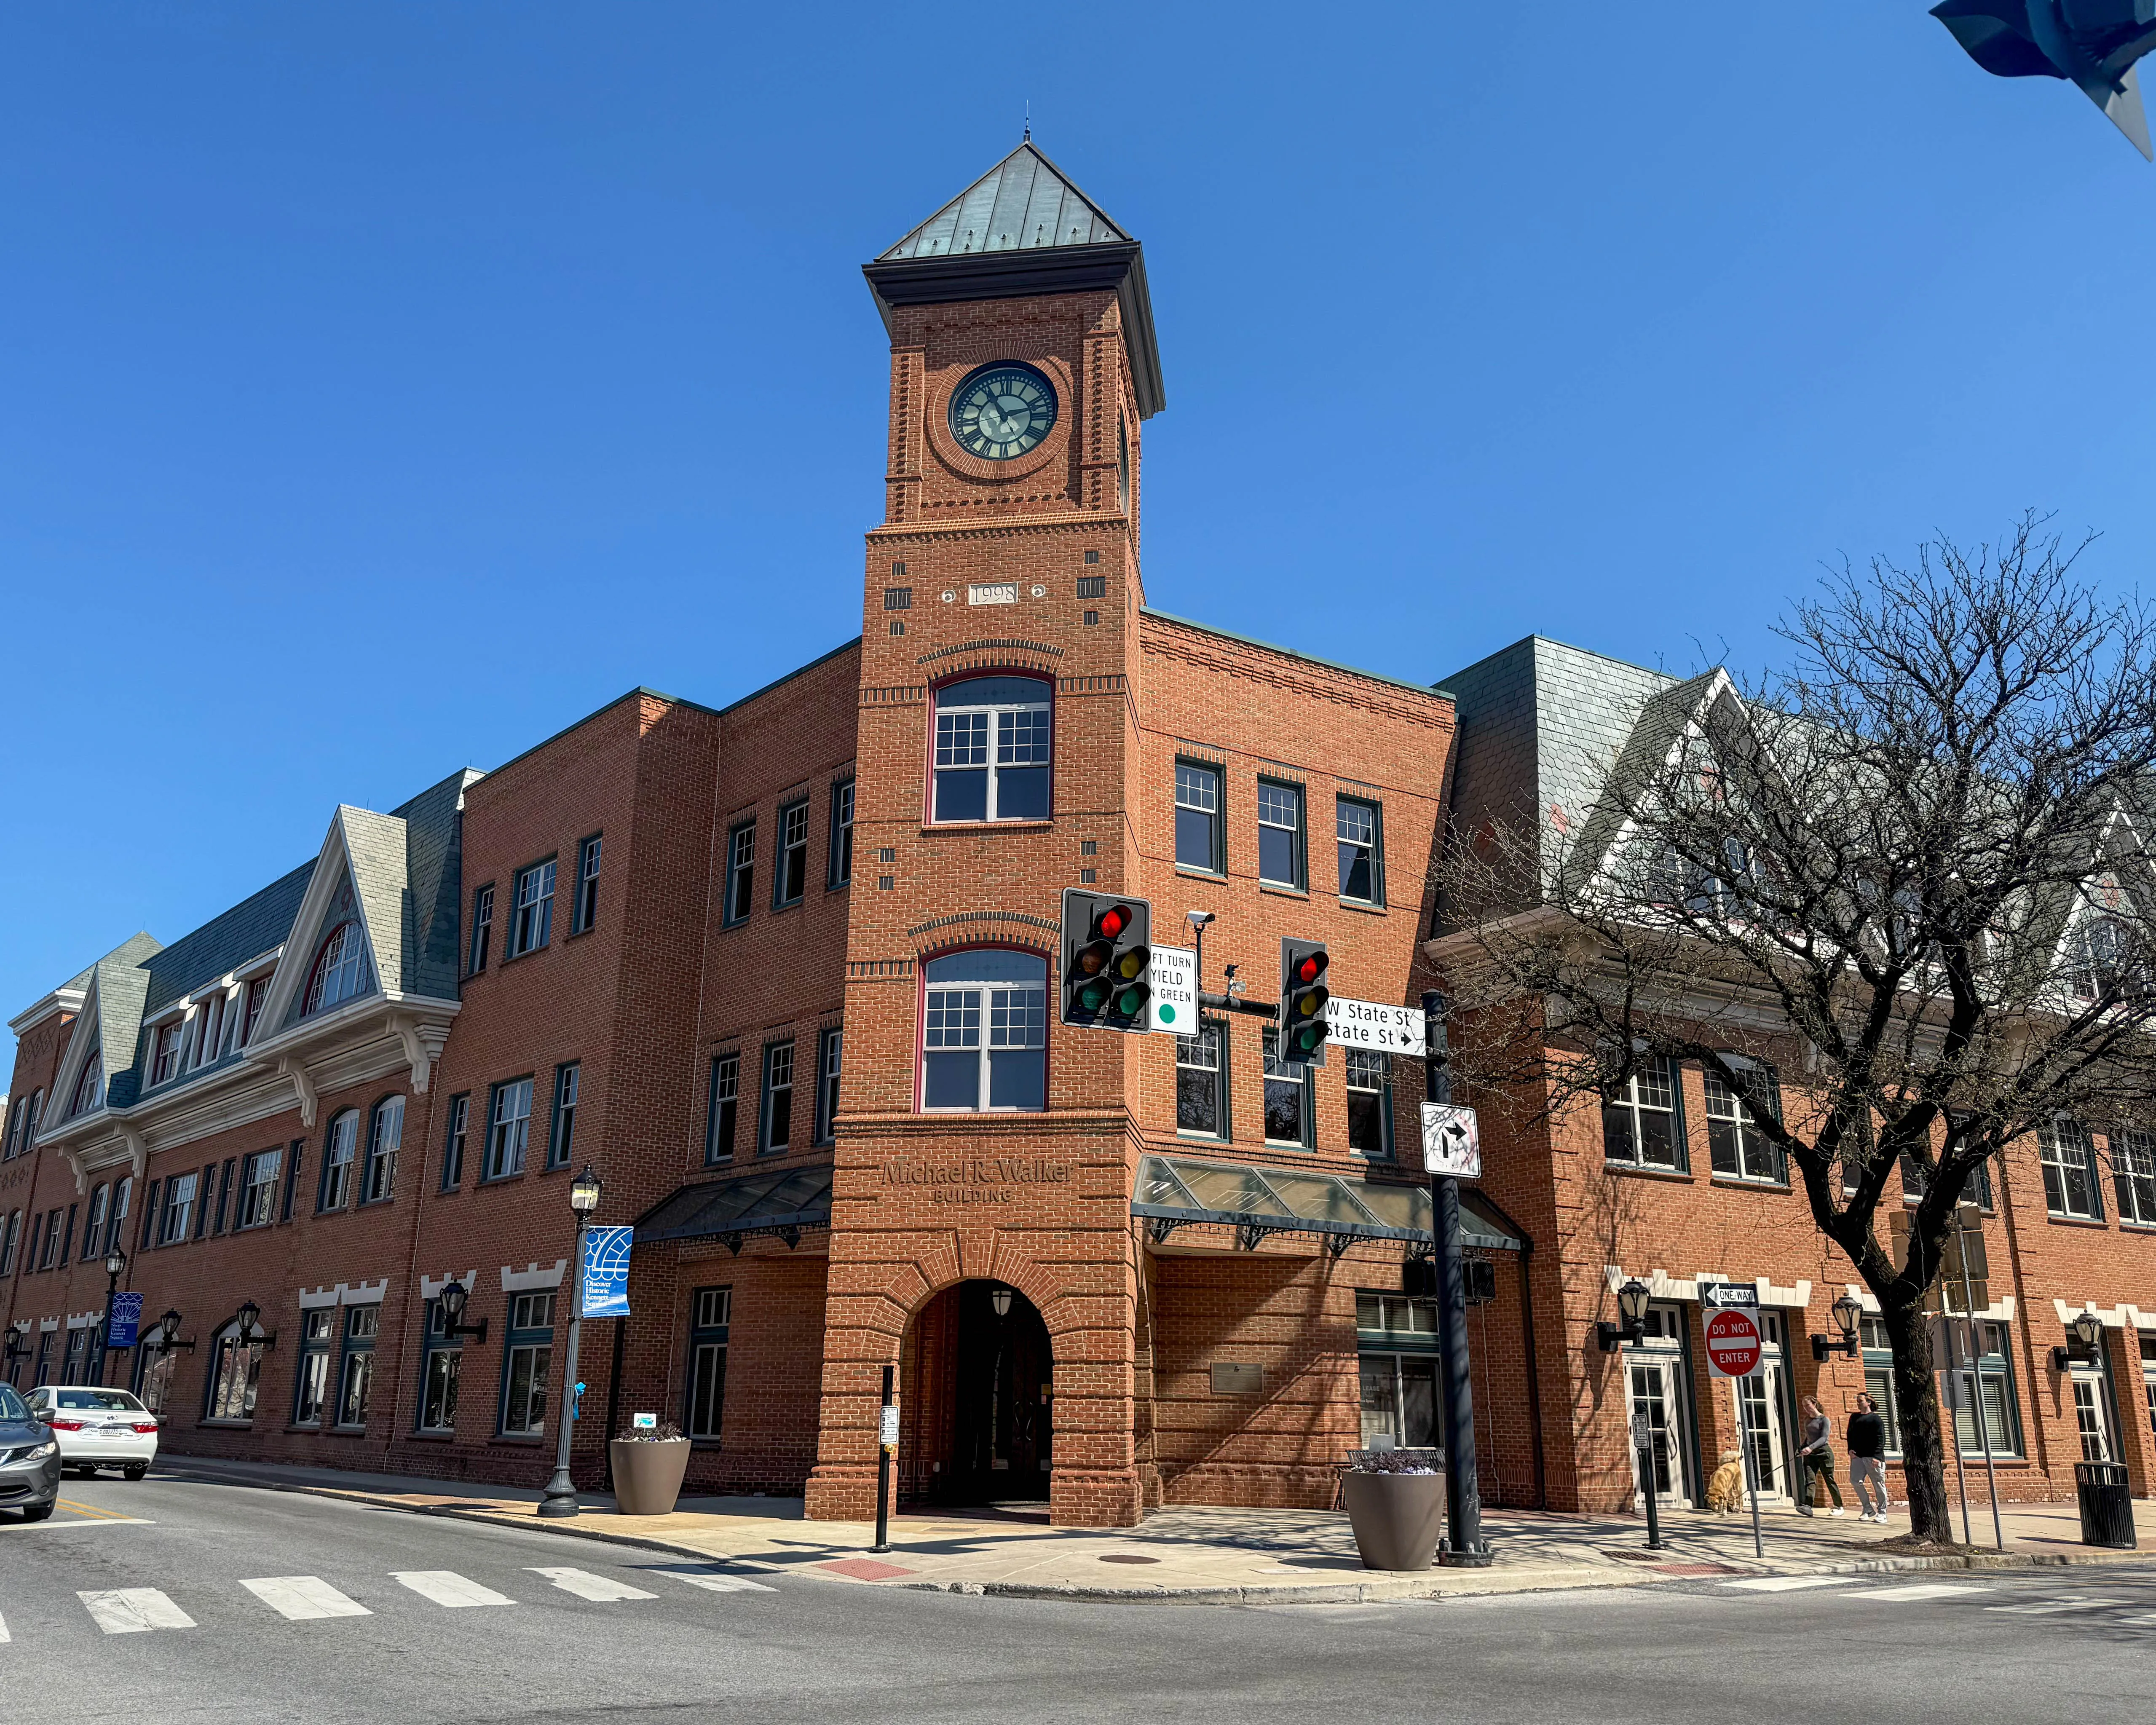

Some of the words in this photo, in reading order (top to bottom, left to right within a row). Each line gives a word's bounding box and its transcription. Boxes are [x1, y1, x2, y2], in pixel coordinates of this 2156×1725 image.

[972, 585, 1015, 603] 1998
[1167, 955, 1191, 969] TURN
[1151, 969, 1183, 985] YIELD
[1160, 988, 1191, 1003] GREEN
[1327, 1000, 1339, 1016] W
[1348, 1004, 1388, 1023] State
[1396, 1011, 1410, 1026] St
[1326, 1021, 1369, 1041] State
[1379, 1029, 1394, 1045] St
[882, 1160, 967, 1184] Michael
[973, 1159, 994, 1184] R.
[997, 1158, 1074, 1183] Walker
[934, 1188, 1012, 1203] BUILDING
[1719, 1290, 1735, 1300] ONE
[1736, 1290, 1752, 1301] WAY
[1712, 1324, 1725, 1335] DO
[1731, 1323, 1750, 1334] NOT
[1719, 1352, 1750, 1363] ENTER
